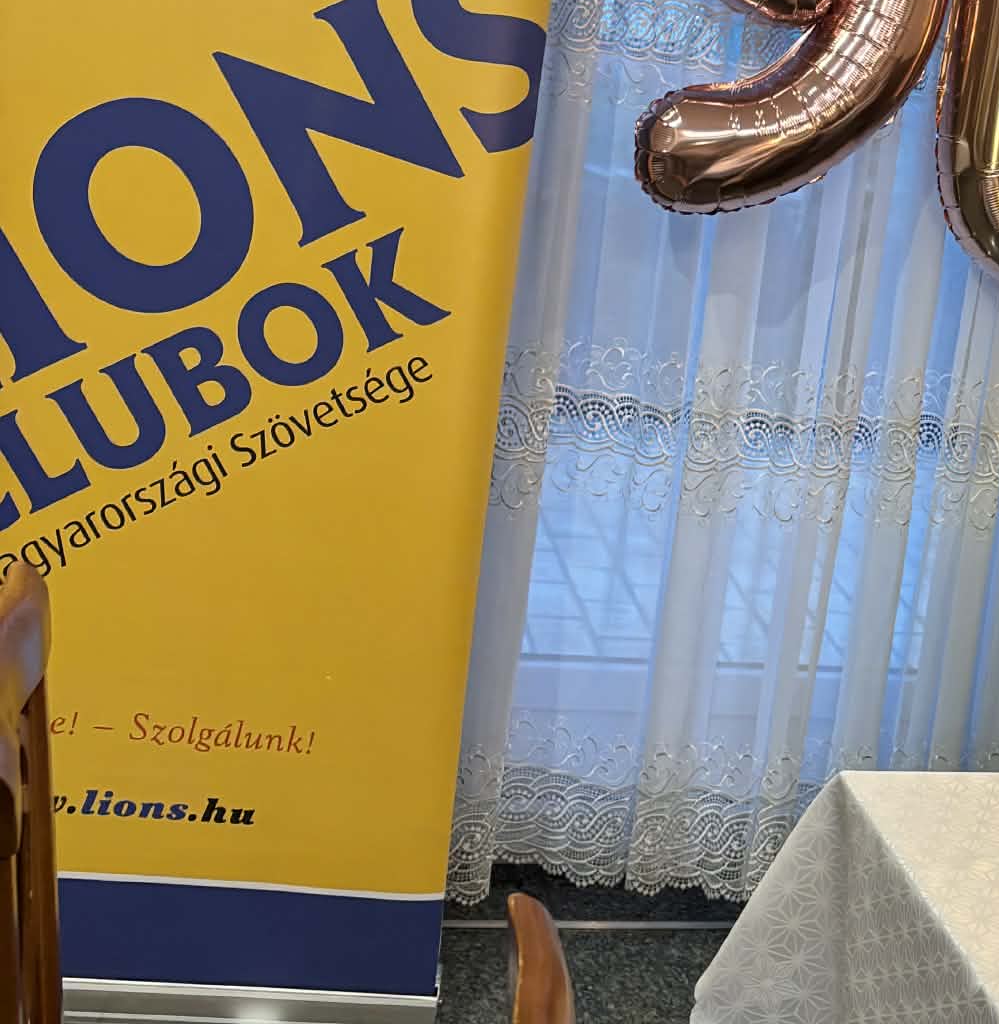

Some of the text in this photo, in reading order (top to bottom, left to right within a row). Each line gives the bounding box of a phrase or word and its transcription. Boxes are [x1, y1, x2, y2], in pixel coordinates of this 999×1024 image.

[0, 227, 452, 532] LUBOK
[0, 354, 434, 582] agyarországi Szövetsége
[129, 712, 316, 756] Szolgálunk!
